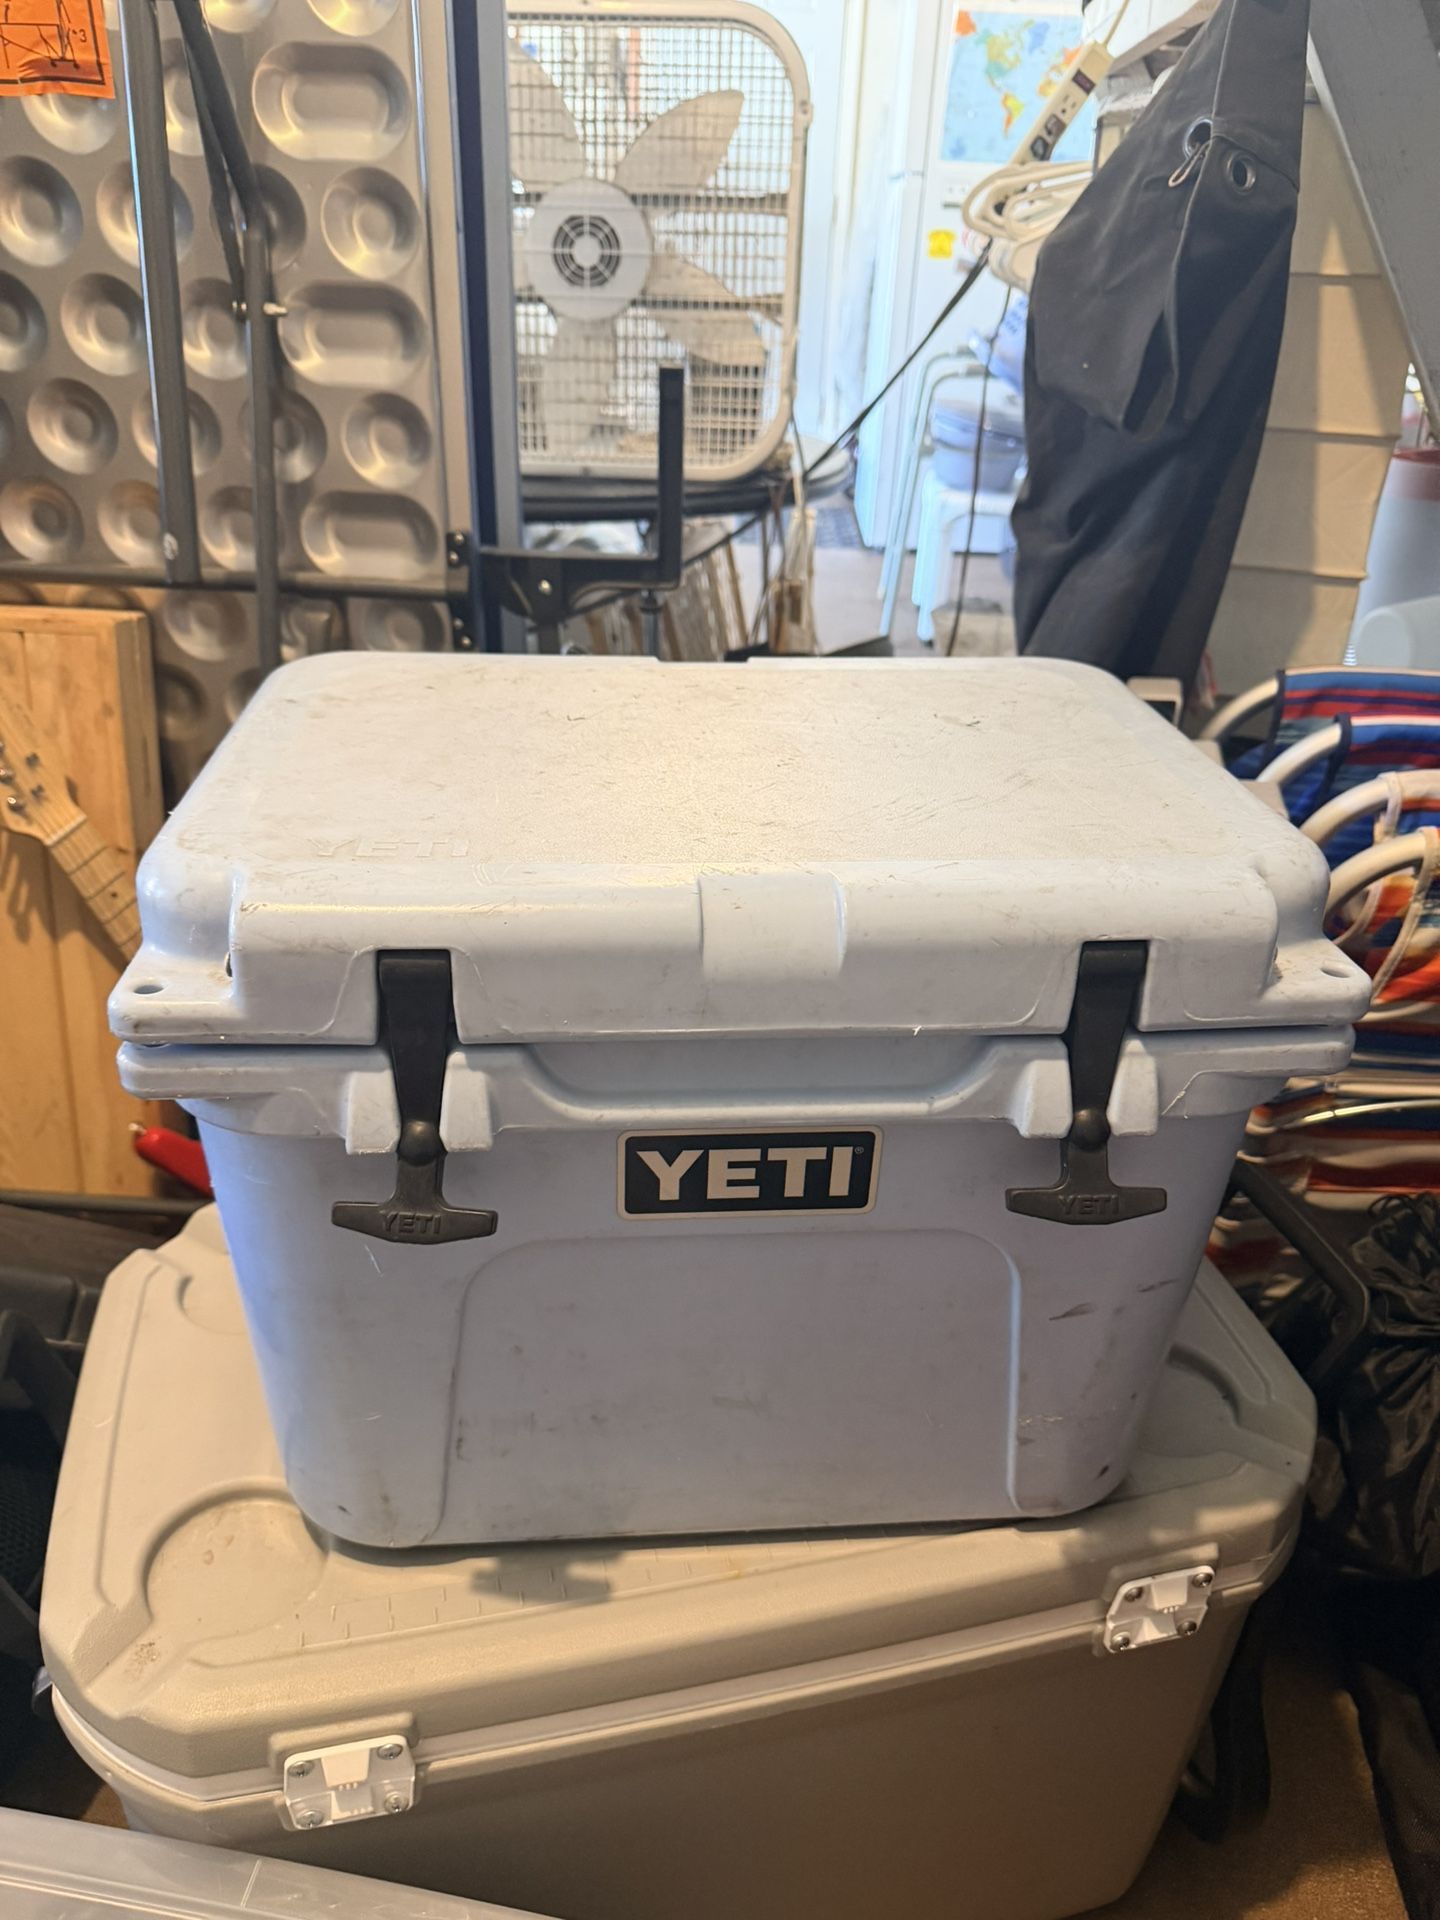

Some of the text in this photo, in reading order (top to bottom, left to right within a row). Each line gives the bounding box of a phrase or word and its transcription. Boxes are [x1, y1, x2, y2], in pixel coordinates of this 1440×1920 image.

[306, 837, 469, 857] YETI
[636, 1146, 854, 1200] YETI
[1058, 1193, 1120, 1215] YETI
[379, 1209, 442, 1235] YETI
